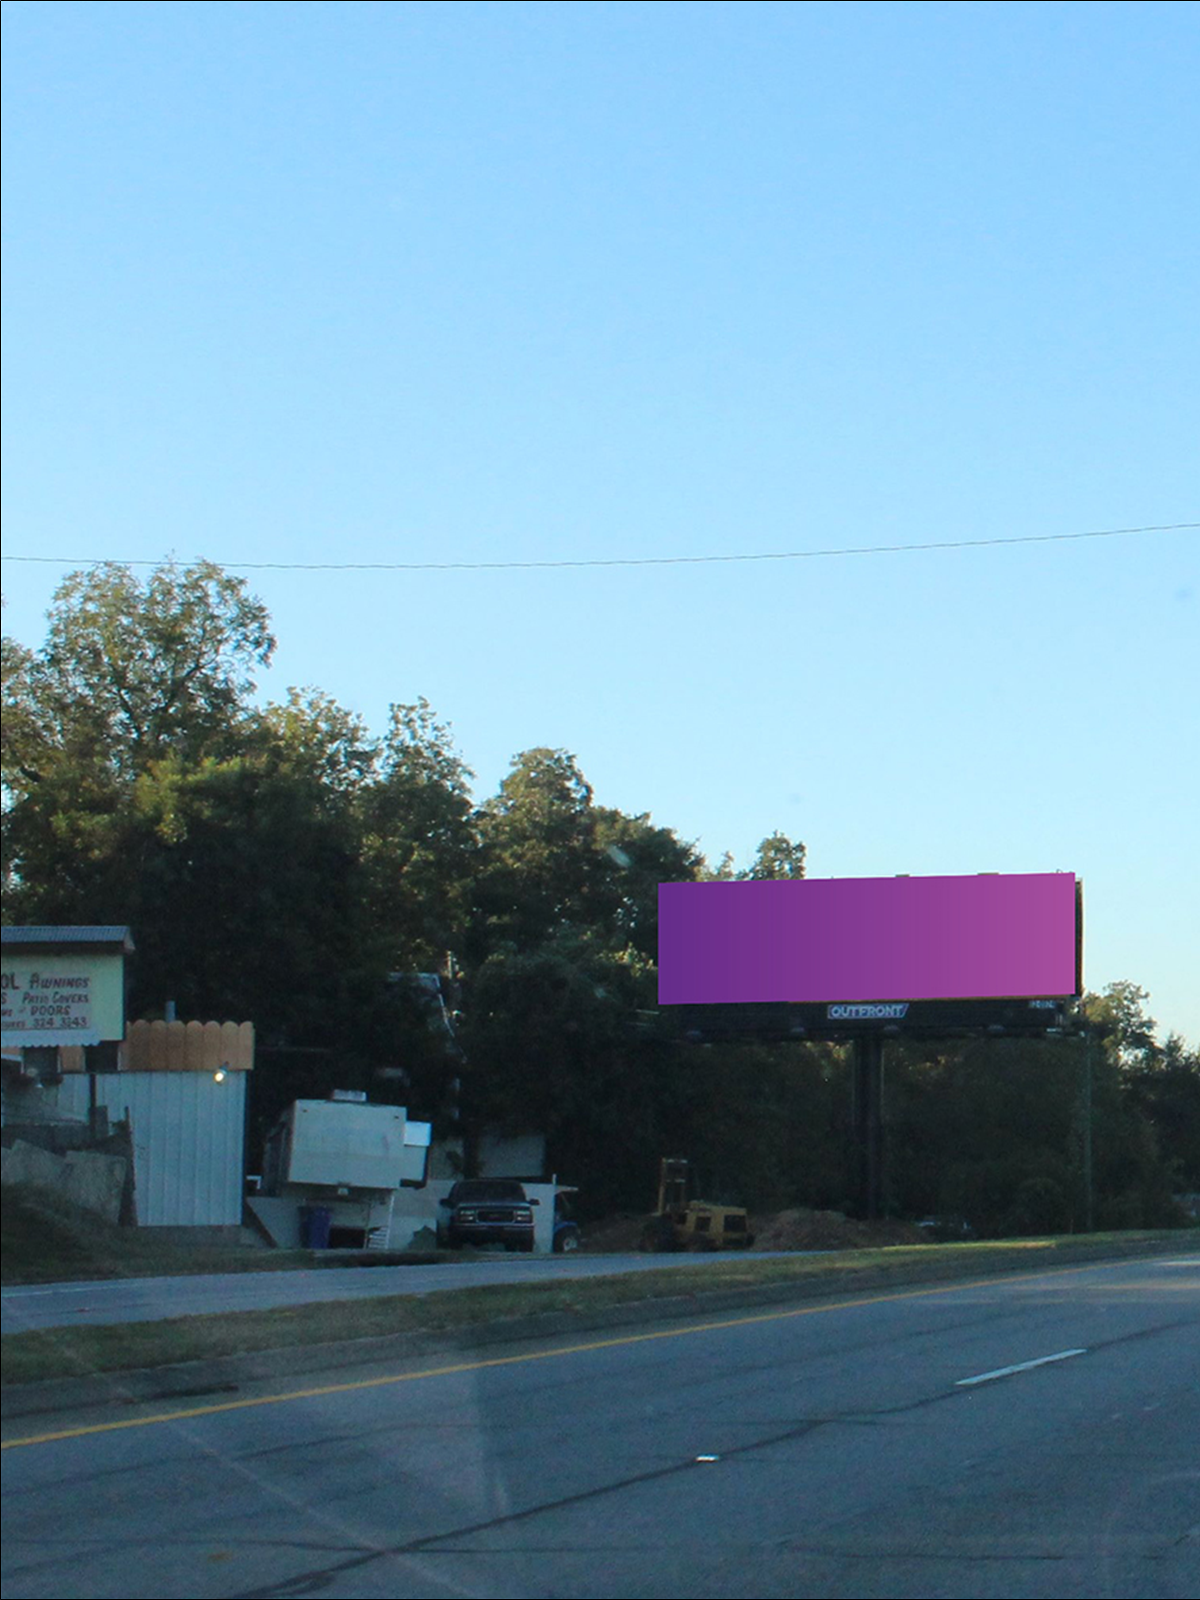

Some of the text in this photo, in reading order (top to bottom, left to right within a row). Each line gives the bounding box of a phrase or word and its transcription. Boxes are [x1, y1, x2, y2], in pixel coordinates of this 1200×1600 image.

[29, 972, 90, 989] AWNINGS
[30, 1004, 71, 1016] DOORS
[831, 1005, 904, 1018] OUTFRONT
